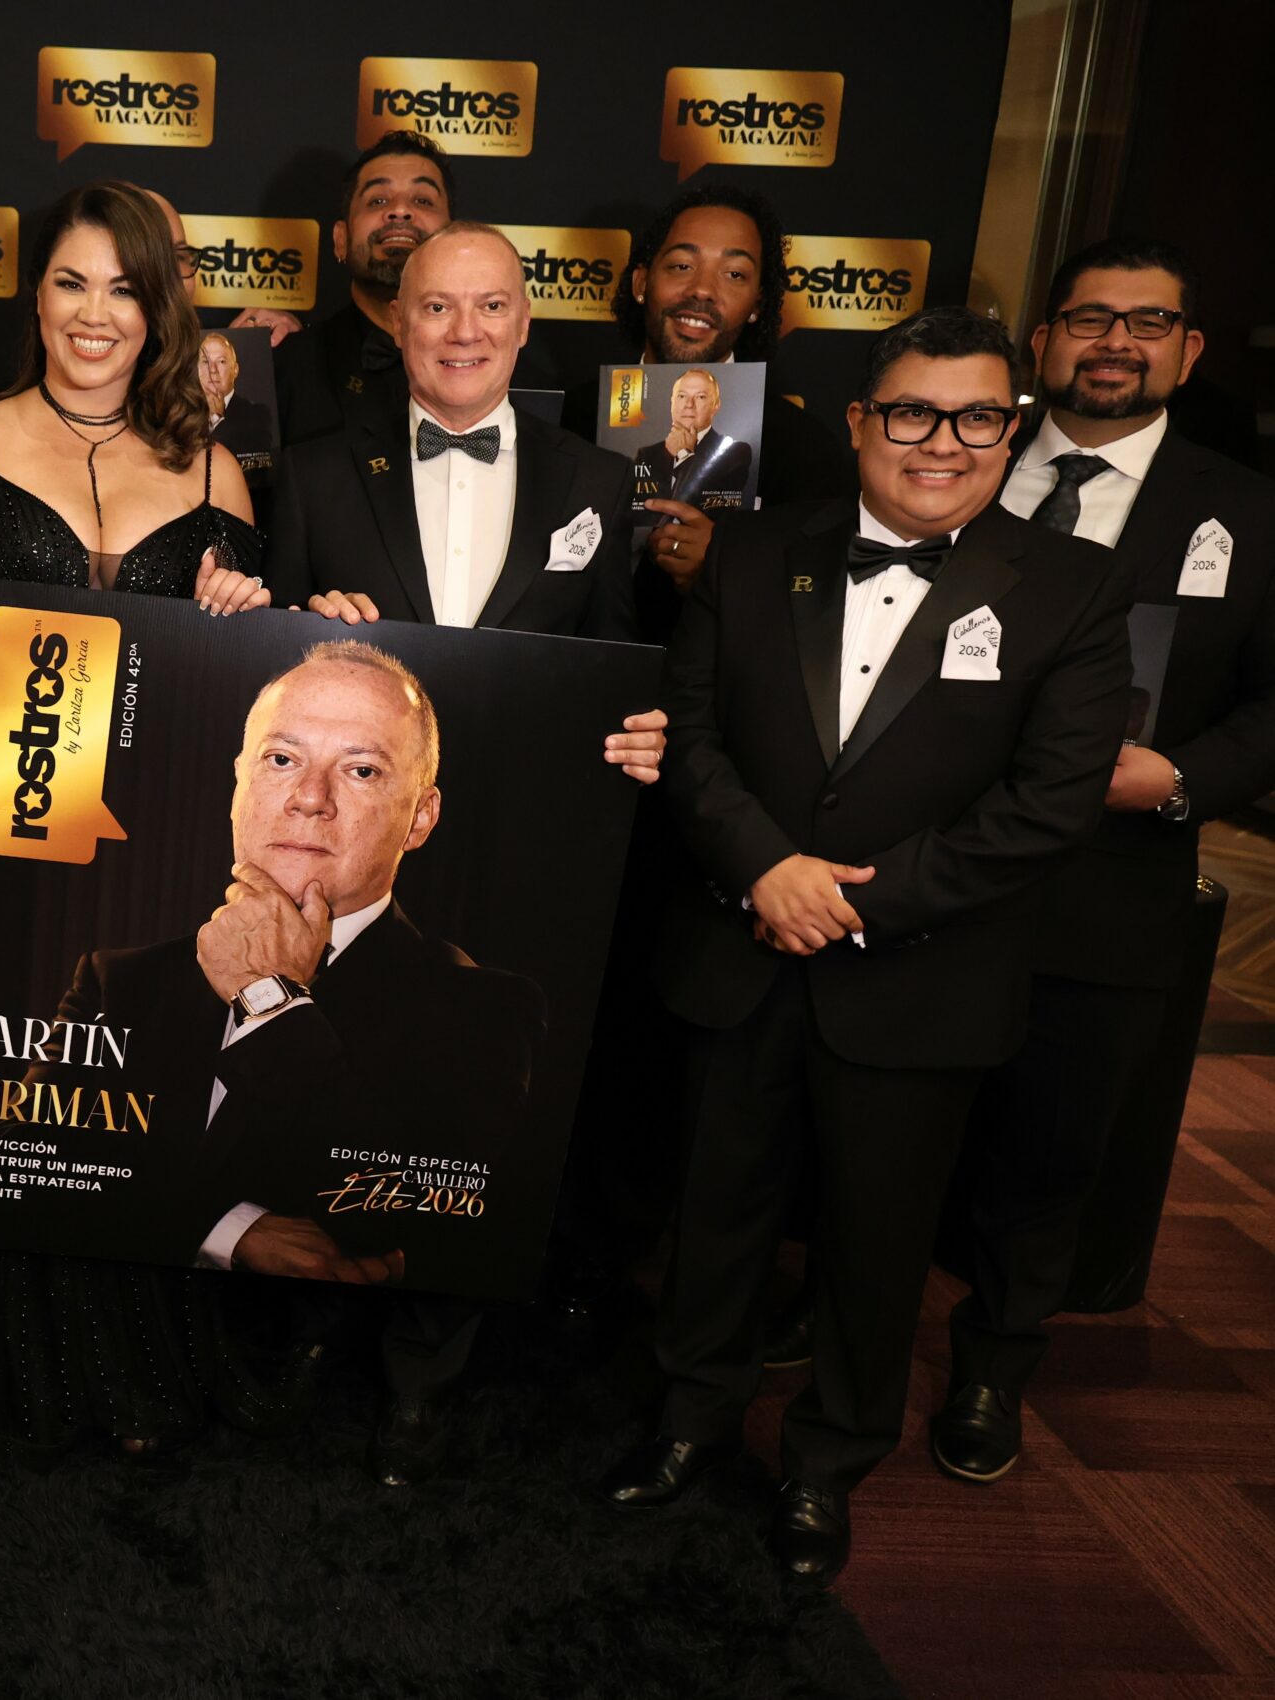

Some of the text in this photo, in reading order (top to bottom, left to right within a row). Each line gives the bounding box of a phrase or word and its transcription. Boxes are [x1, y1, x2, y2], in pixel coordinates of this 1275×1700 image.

[53, 73, 199, 110] rostros
[373, 82, 520, 119] rostros
[95, 109, 198, 127] MAGAZINE
[677, 92, 825, 130] rostros
[414, 118, 518, 136] MAGAZINE
[717, 129, 822, 146] MAGAZINE
[199, 238, 303, 275] stros
[522, 249, 613, 285] stros
[199, 273, 302, 291] MAGAZINE
[785, 259, 912, 296] ostros
[527, 284, 610, 301] AGAZINE
[806, 294, 908, 312] MAGAZINE
[368, 457, 390, 474] R
[569, 543, 586, 556] 2026
[1192, 560, 1217, 570] 2026
[791, 576, 813, 592] R
[959, 644, 987, 657] 2026
[63, 639, 91, 754] by Laritza García
[120, 683, 138, 748] EDICIÓN
[9, 632, 68, 840] rostros
[47, 1160, 67, 1172] UN
[72, 1163, 132, 1178] IMPERIO
[330, 1148, 491, 1174] EDICIÓN ESPECIAL
[9, 1172, 102, 1192] ESTRATEGIA
[401, 1169, 486, 1191] CABALLERO
[417, 1185, 484, 1217] 2026
